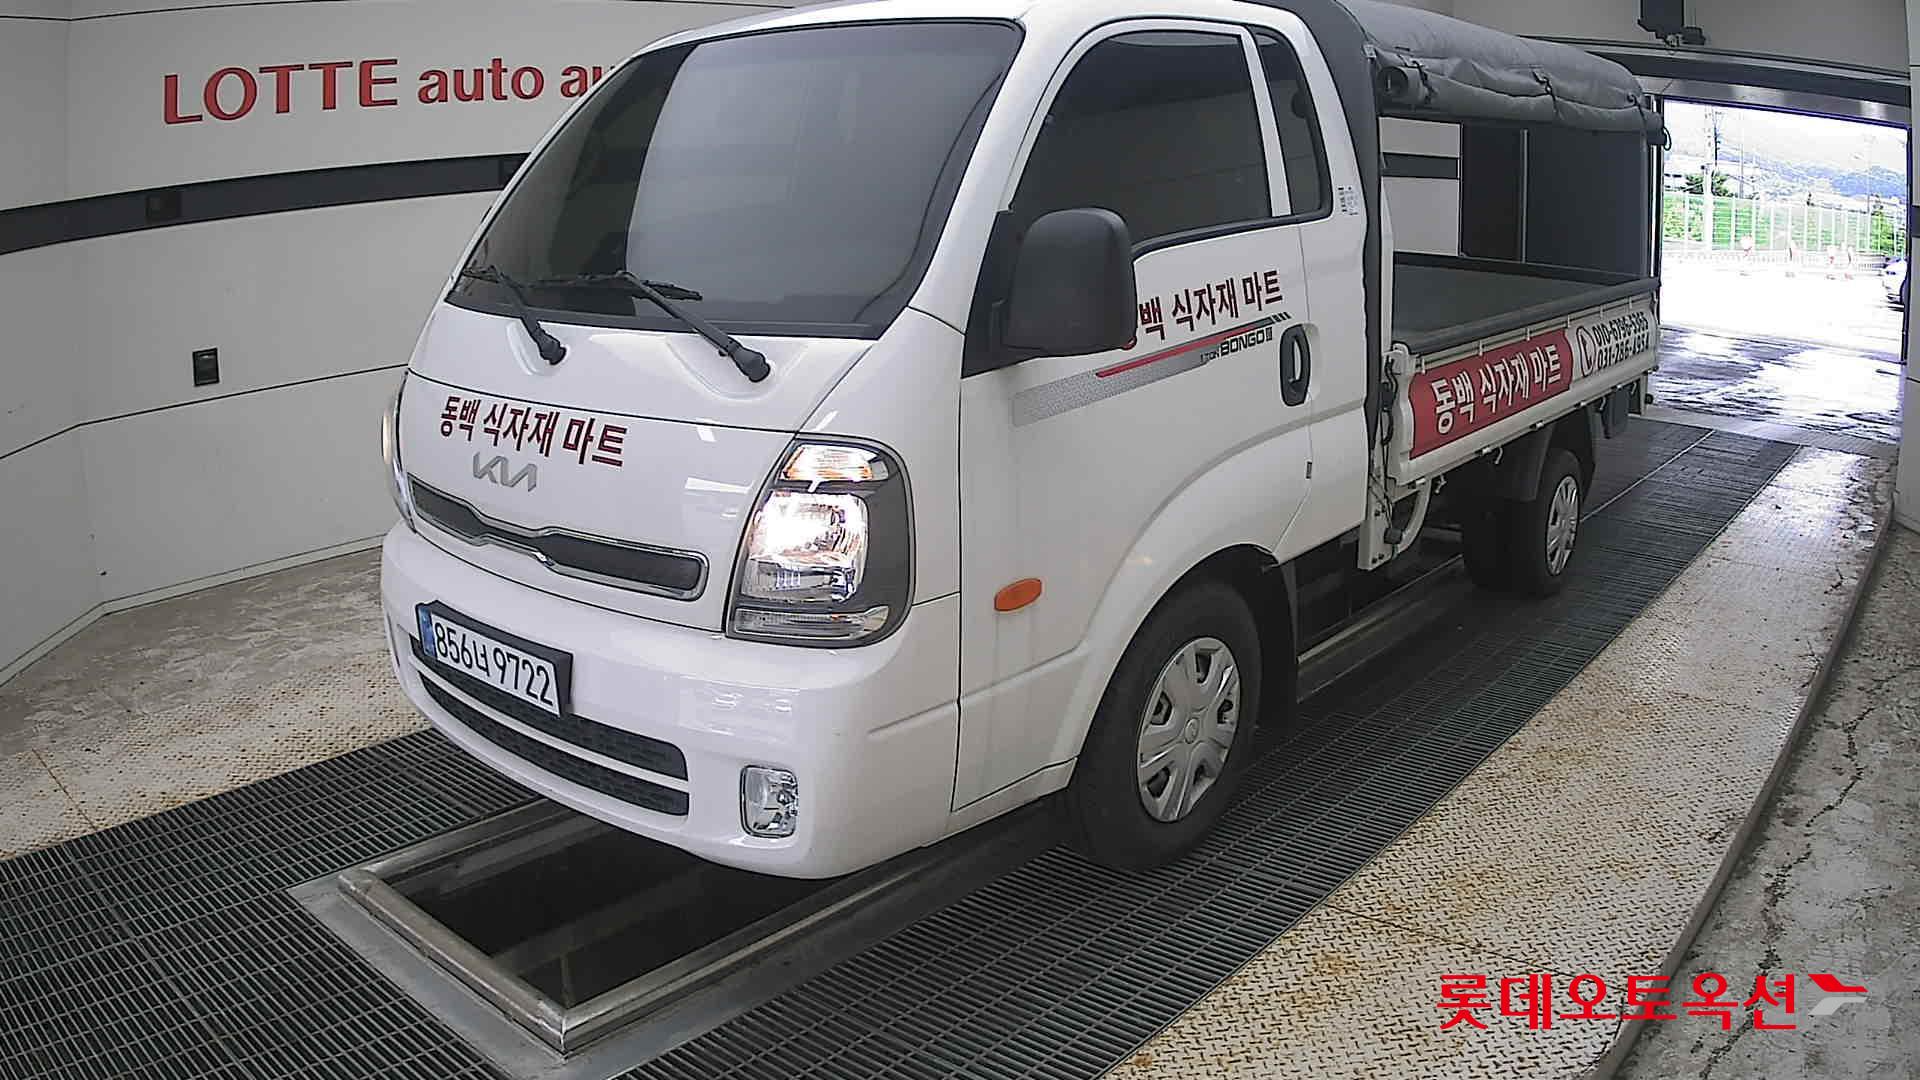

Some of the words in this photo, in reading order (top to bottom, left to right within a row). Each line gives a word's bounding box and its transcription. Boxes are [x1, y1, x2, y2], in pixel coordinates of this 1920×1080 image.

[164, 58, 398, 125] LOTTE
[417, 57, 544, 104] auto
[1172, 277, 1239, 331] 식자재
[1241, 269, 1284, 311] 마트
[1220, 329, 1265, 357] BONGO
[1431, 370, 1474, 434] 동백
[1479, 351, 1530, 413] 식자재
[1528, 344, 1562, 392] 마트
[440, 395, 481, 442] 동백
[483, 403, 560, 458] 식자재
[562, 417, 628, 468] 마트
[492, 647, 554, 707] 9722
